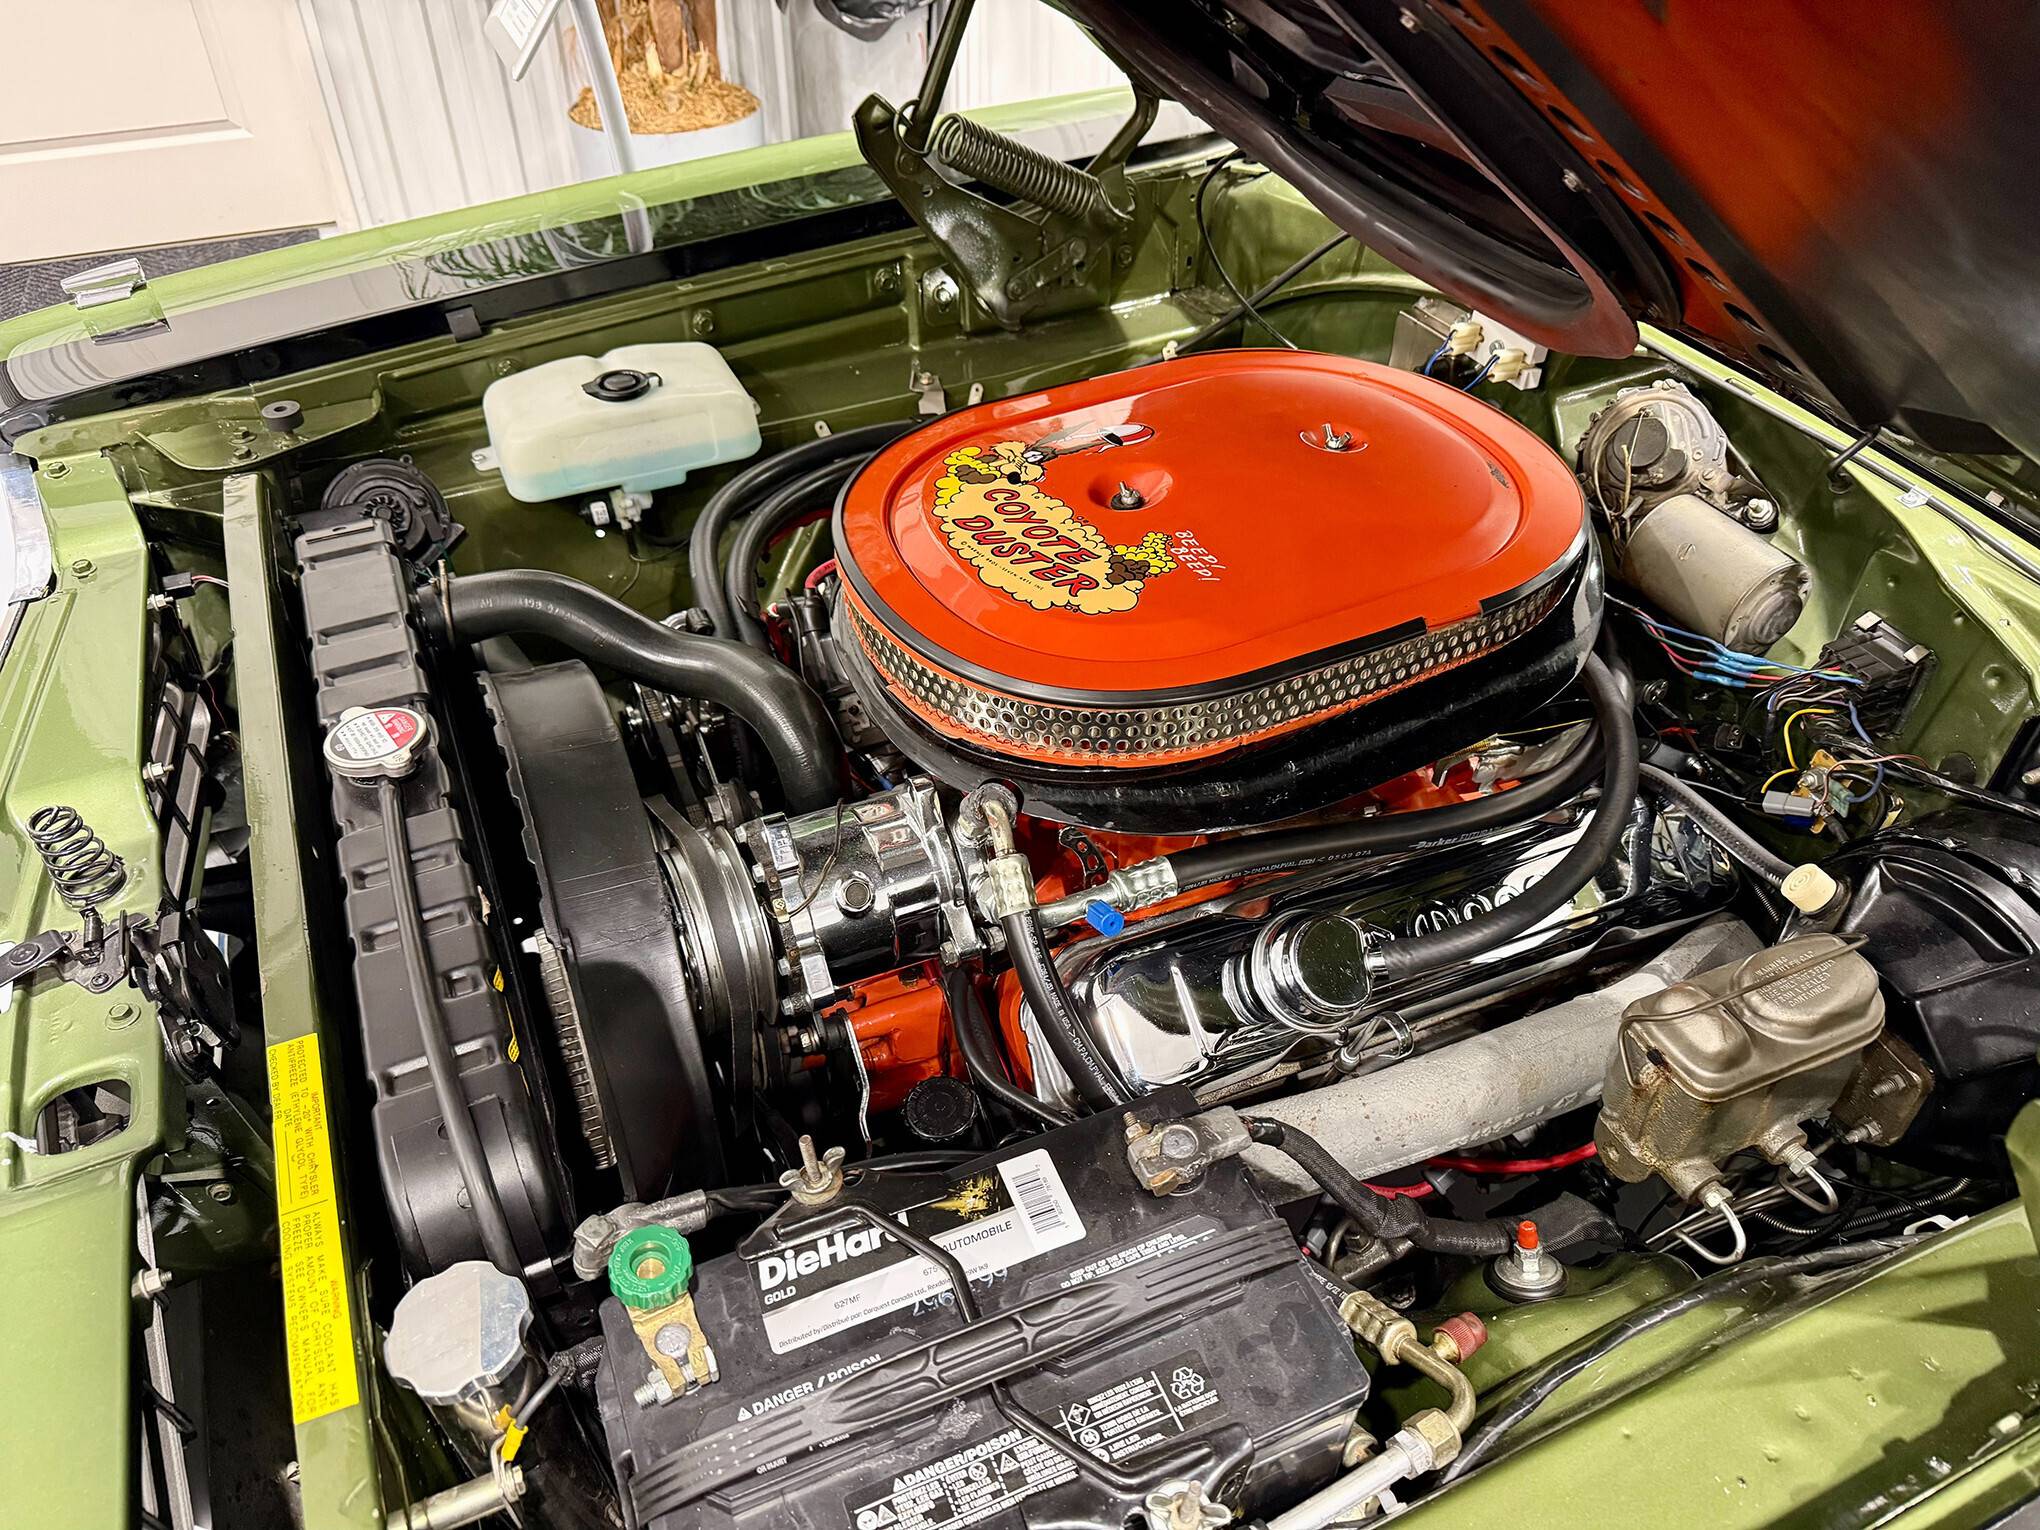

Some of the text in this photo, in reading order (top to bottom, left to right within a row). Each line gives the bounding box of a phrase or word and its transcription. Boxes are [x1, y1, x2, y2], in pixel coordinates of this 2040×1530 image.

[984, 488, 1101, 565] COYOTE
[951, 515, 1100, 597] DUSTER
[1169, 545, 1221, 582] BEEP!
[1174, 530, 1226, 572] BEEP!
[1062, 1015, 1071, 1030] USA
[296, 1040, 308, 1083] PROTECTED
[268, 1049, 282, 1120] CHECKED BY DEALER
[301, 1088, 309, 1098] TO
[283, 1109, 292, 1127] DATE
[287, 1044, 308, 1199] ANTIFREEZE (ETHYLENE GLYCOL TYPE)
[311, 1092, 322, 1130] IMPORTANT
[305, 1129, 315, 1148] WITH
[307, 1153, 319, 1196] CHRYSLER
[282, 1222, 292, 1260] COOLING
[292, 1218, 303, 1252] FREEZE
[302, 1214, 313, 1248] PROPER
[941, 1219, 1013, 1252] AUTOMOBILE
[284, 1266, 297, 1308] SYSTEMS
[295, 1262, 305, 1279] SEE
[306, 1256, 317, 1294] AMOUNT
[310, 1301, 319, 1313] OF
[312, 1211, 339, 1406] ALWAYS MAKE SURE COOLANT HAS
[330, 1280, 341, 1319] WARNING
[764, 1285, 797, 1306] GOLD
[779, 1331, 817, 1348] Distributed
[891, 1293, 914, 1306] Canada
[302, 1339, 313, 1384] MANUAL
[311, 1321, 324, 1374] CHRYSLER
[306, 1393, 316, 1413] FOR
[752, 1381, 814, 1416] DANGER
[903, 1428, 1022, 1486] DANGER/POISON
